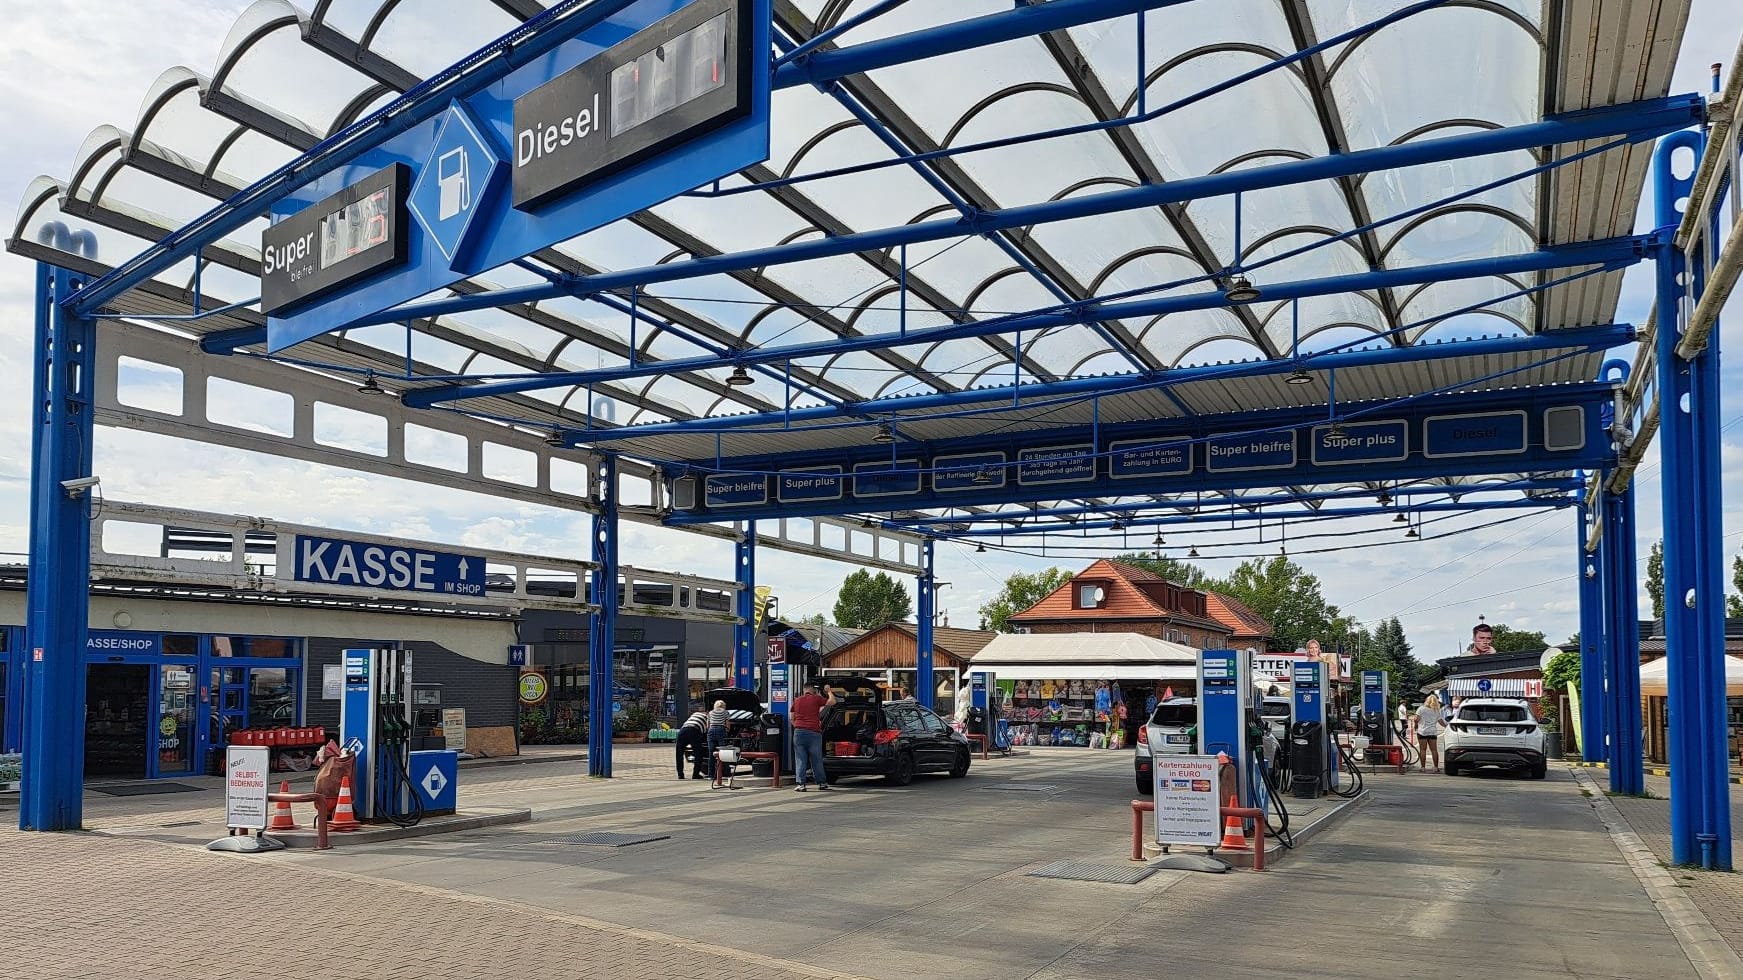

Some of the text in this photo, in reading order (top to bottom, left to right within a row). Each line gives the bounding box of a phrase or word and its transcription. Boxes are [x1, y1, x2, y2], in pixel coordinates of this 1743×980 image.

[518, 92, 599, 168] Diesel
[264, 231, 314, 275] Super
[1323, 434, 1396, 449] Super plus
[1140, 450, 1154, 458] und
[1155, 449, 1182, 457] Karten-
[1211, 445, 1248, 458] Super
[1123, 458, 1151, 467] zahlung
[1160, 456, 1182, 464] EURO
[1021, 467, 1064, 477] durchgehend
[707, 481, 766, 495] Super bleifrei
[785, 477, 835, 489] Super plus
[302, 539, 436, 590] KASSE
[444, 581, 481, 594] IM SHOP
[86, 638, 153, 649] ASSE/SHOP
[1252, 660, 1294, 669] ETTEN
[158, 738, 180, 749] SHOP
[1158, 762, 1212, 770] Kartenzahlung
[234, 771, 260, 779] SELBST-
[230, 780, 264, 788] BEDIENUNG
